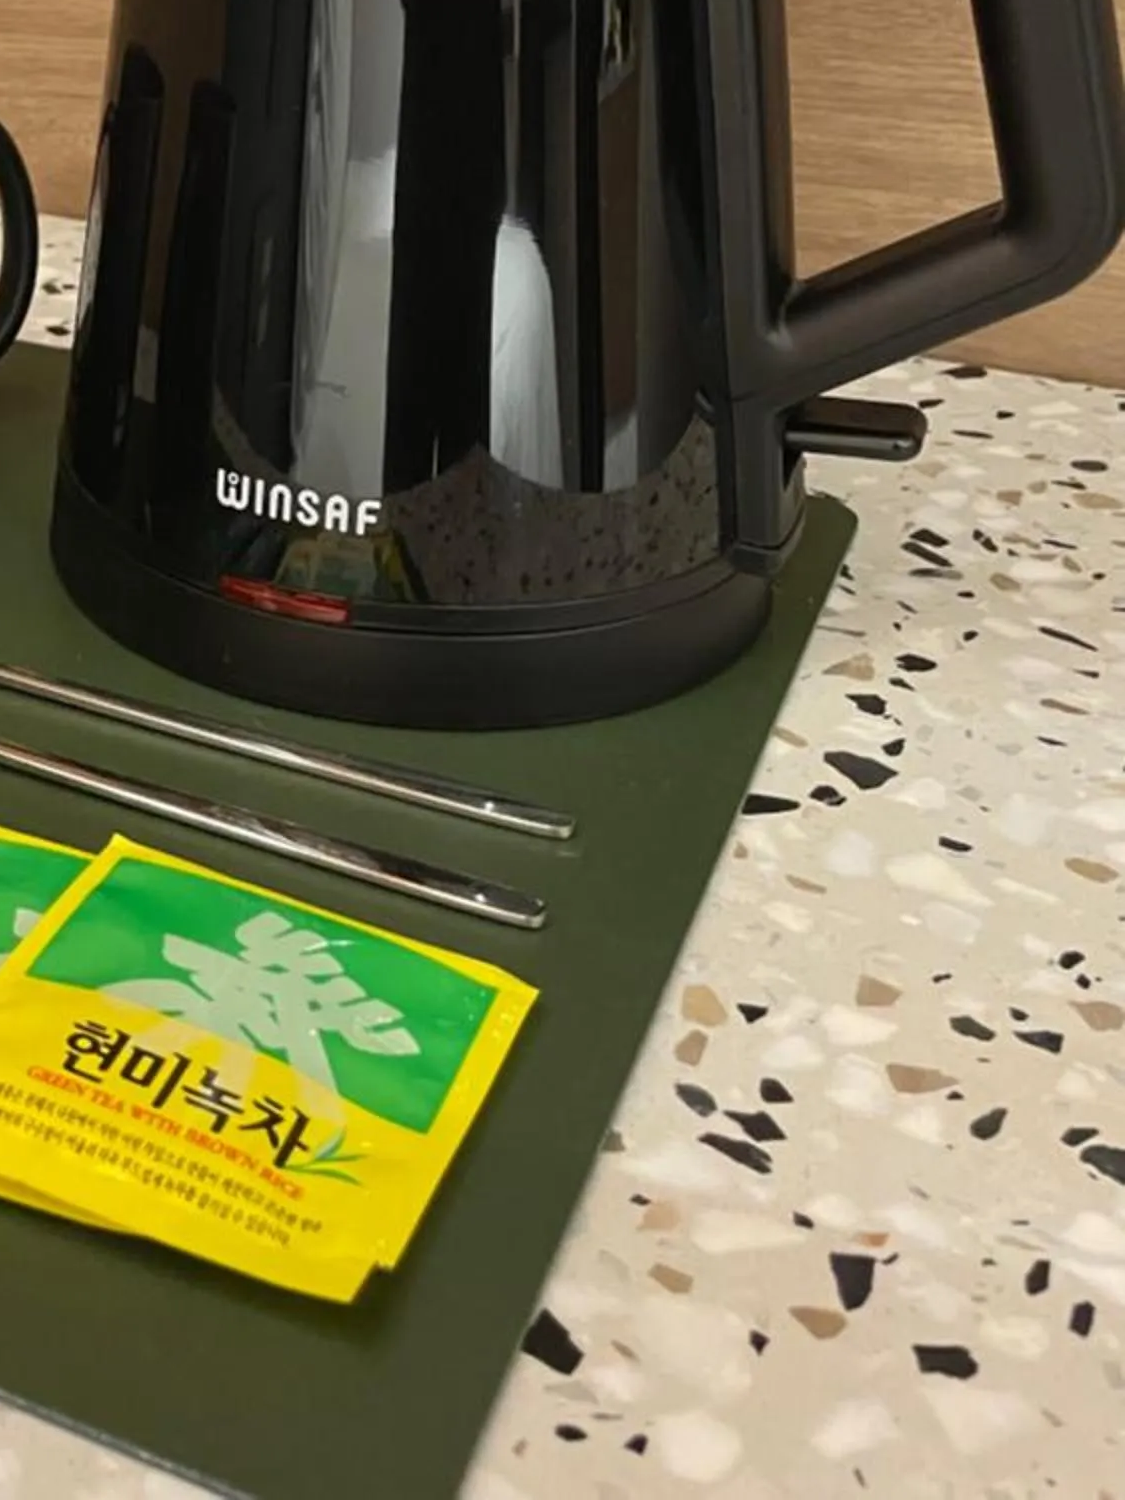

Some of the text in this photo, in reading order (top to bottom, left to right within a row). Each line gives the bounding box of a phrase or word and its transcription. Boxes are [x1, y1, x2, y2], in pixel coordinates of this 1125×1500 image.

[215, 467, 383, 536] WINSAF
[27, 1065, 85, 1097] GREEN
[89, 1088, 125, 1113] TEA
[185, 1127, 259, 1170] BROWN
[259, 1165, 305, 1201] RICE
[62, 1020, 310, 1169] 현미녹차
